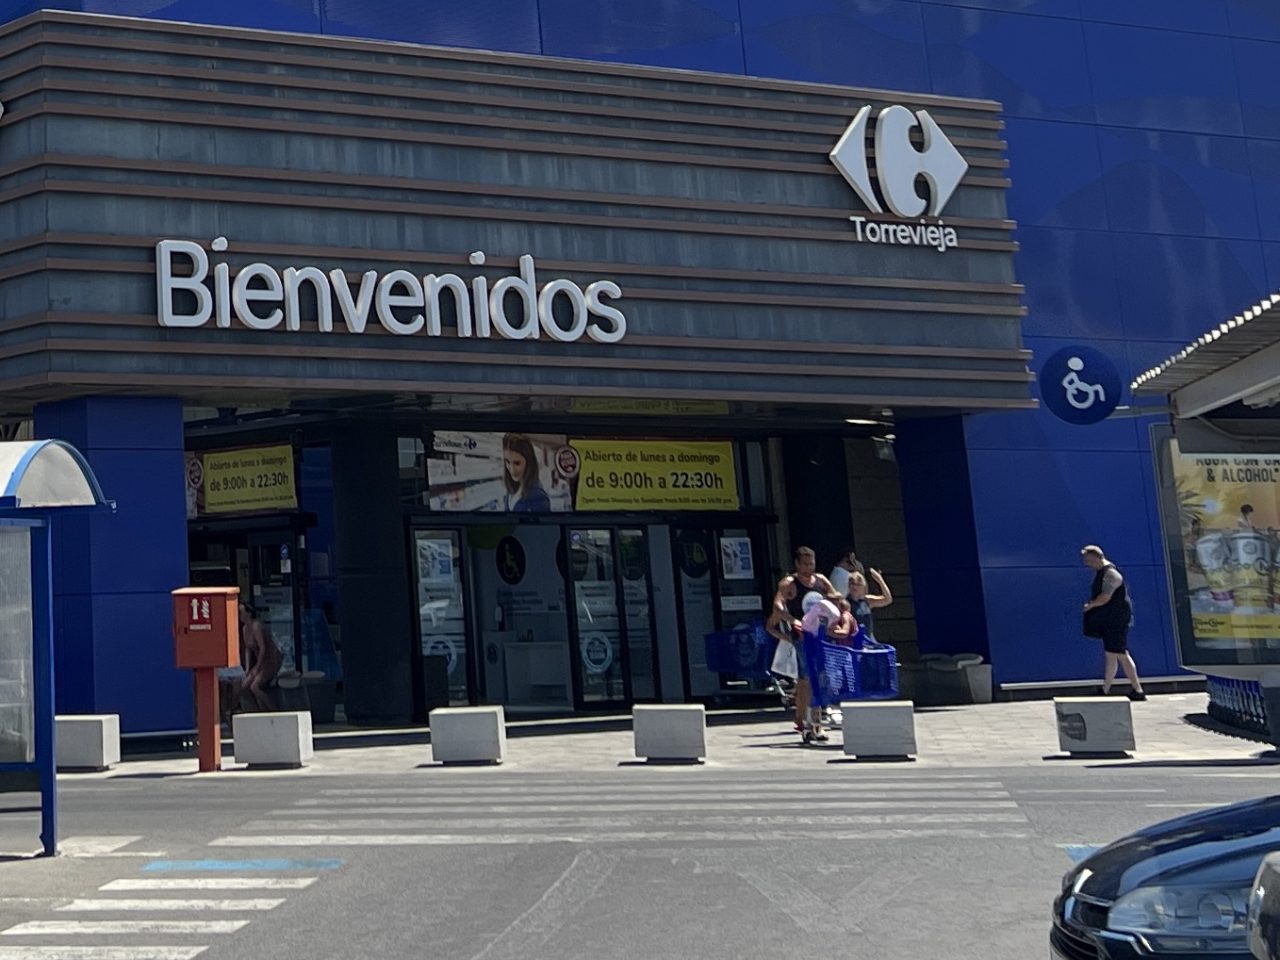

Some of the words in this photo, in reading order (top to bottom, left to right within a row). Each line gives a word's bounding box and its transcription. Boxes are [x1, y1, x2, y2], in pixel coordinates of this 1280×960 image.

[849, 216, 959, 252] Torrevieja
[156, 236, 627, 343] Bienvenidos
[584, 450, 622, 463] Abierto
[625, 450, 638, 463] de
[640, 450, 666, 463] lunes
[669, 454, 675, 463] a
[677, 451, 721, 465] domingo
[210, 479, 221, 492] de
[250, 479, 256, 489] a
[585, 471, 605, 489] de
[609, 471, 653, 489] 9:00h
[658, 476, 667, 489] a
[670, 471, 724, 489] 22:30h
